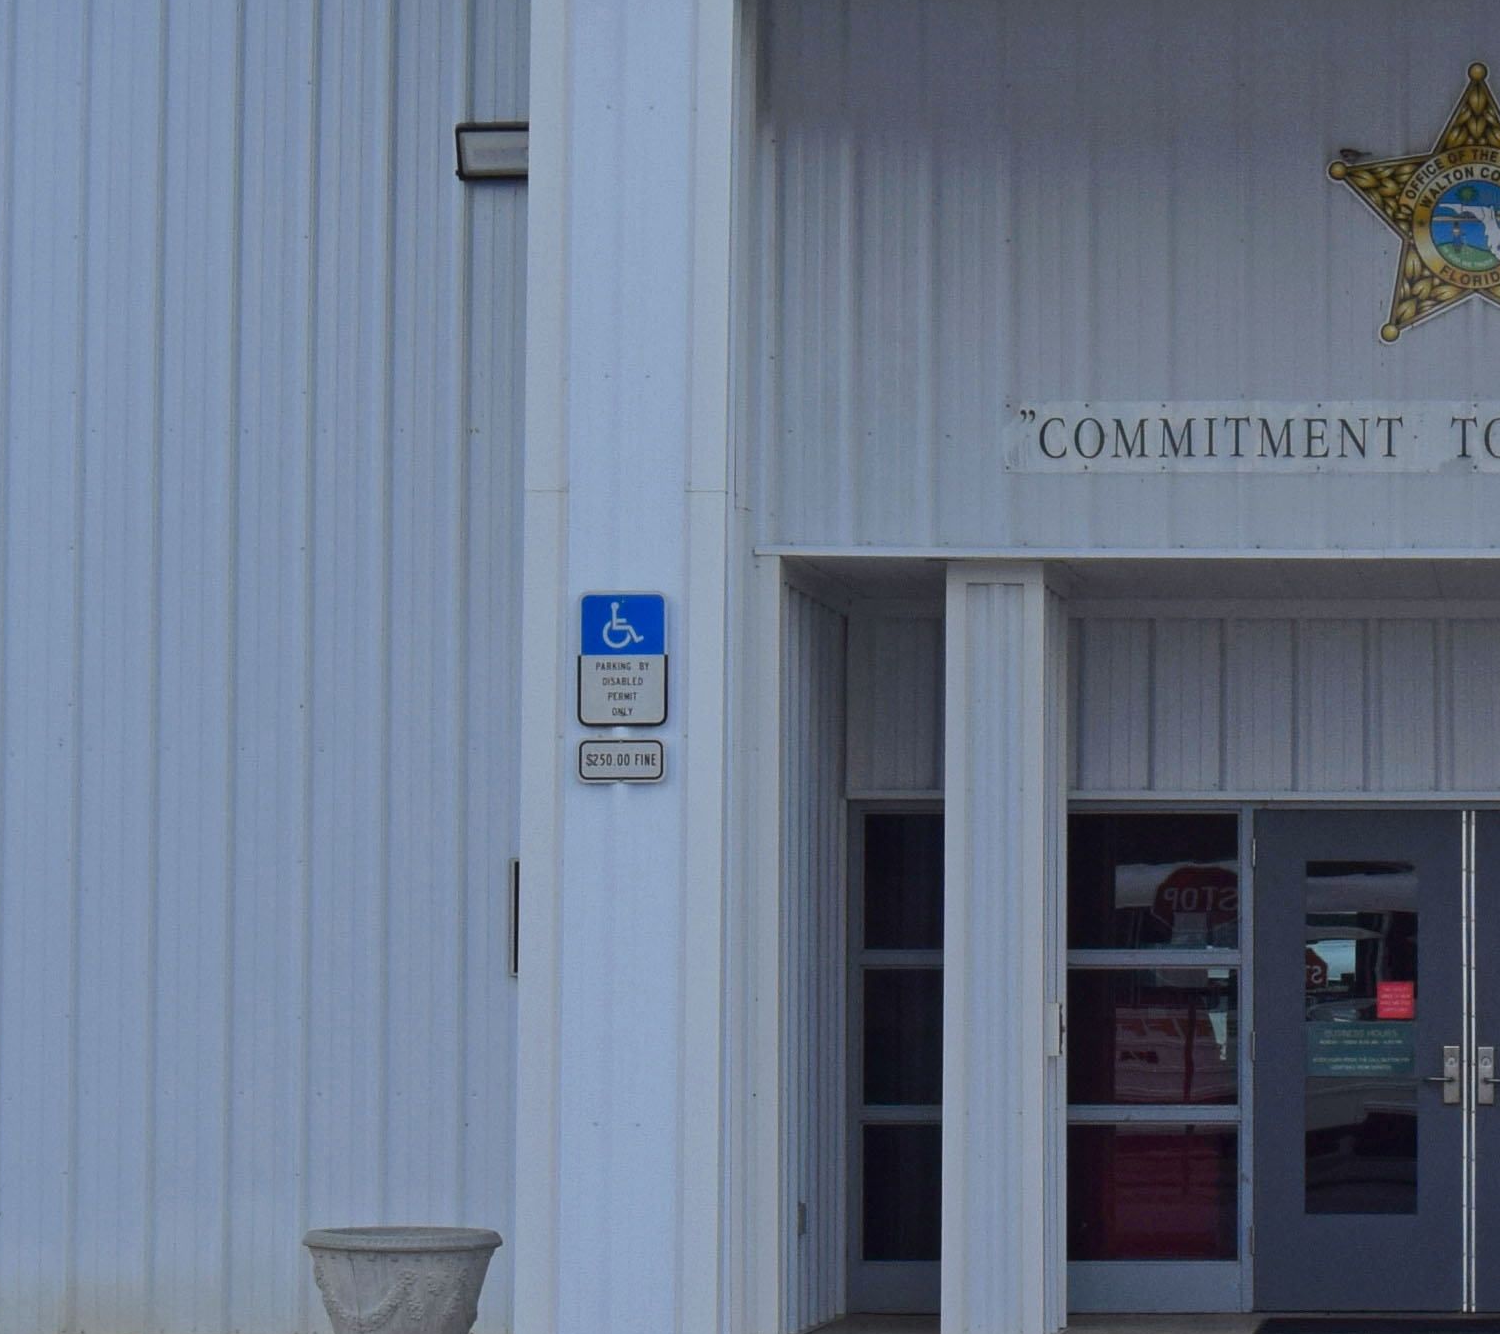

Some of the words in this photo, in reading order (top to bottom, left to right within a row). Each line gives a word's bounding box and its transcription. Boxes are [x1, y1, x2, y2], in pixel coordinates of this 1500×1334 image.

[1405, 157, 1444, 200] OFFICE
[1447, 152, 1467, 166] OF
[1472, 151, 1499, 163] THE
[1420, 167, 1474, 208] WALTON
[595, 662, 632, 671] PARKING
[639, 662, 649, 671] BY
[602, 677, 643, 686] DISABLED
[607, 692, 637, 701] PERMIT
[611, 707, 633, 716] ONLY
[585, 754, 630, 767] $250.00
[635, 754, 657, 767] FINE
